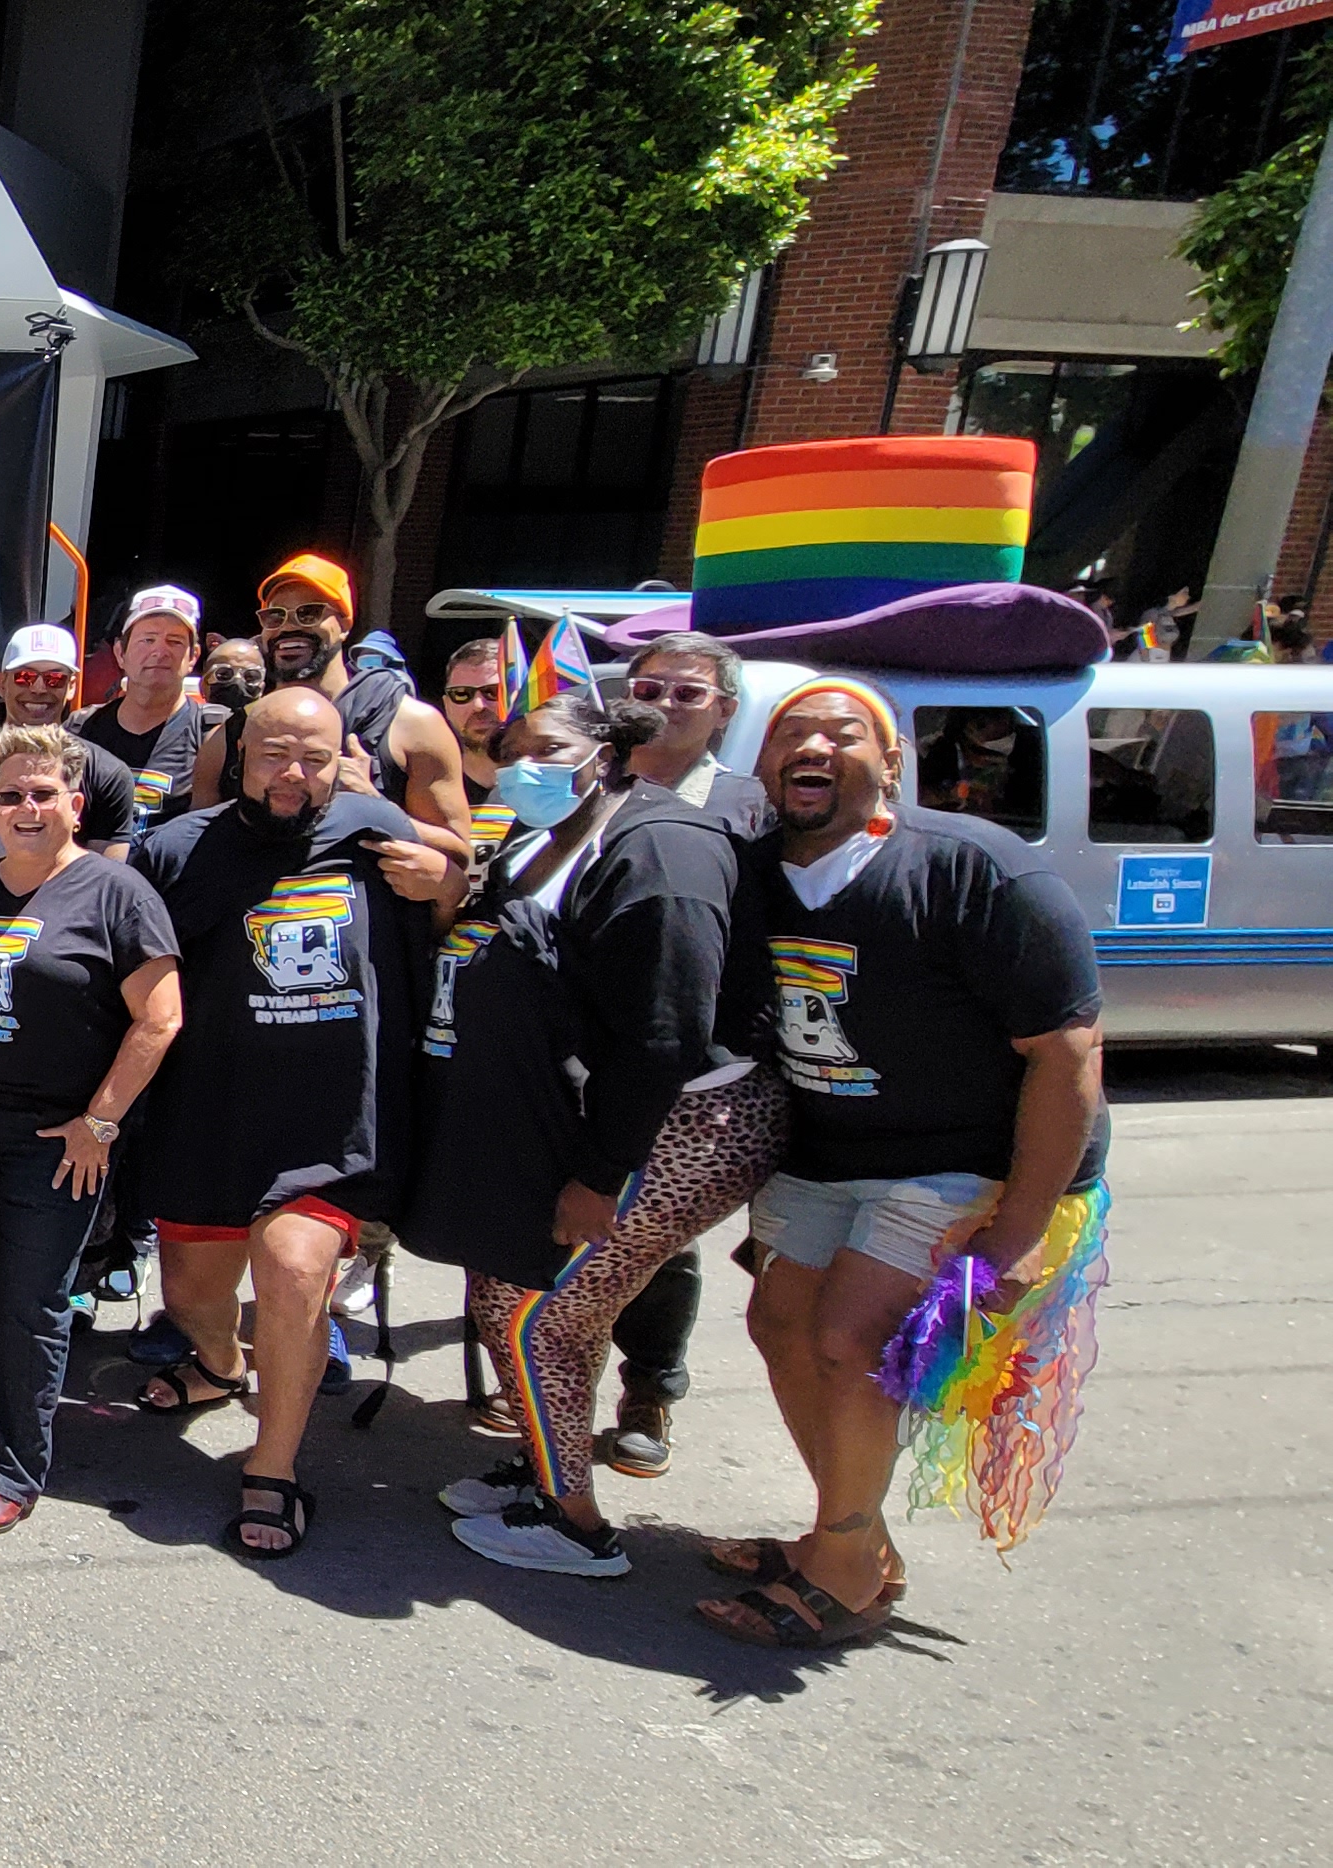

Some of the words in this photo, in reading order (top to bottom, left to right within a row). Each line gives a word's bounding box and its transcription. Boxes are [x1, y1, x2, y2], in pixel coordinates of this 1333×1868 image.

[1181, 18, 1217, 38] MBA
[1219, 14, 1244, 28] for
[248, 994, 266, 1008] 50
[265, 994, 310, 1009] YEARS
[255, 1010, 274, 1024] 50
[272, 1009, 318, 1024] YEARS
